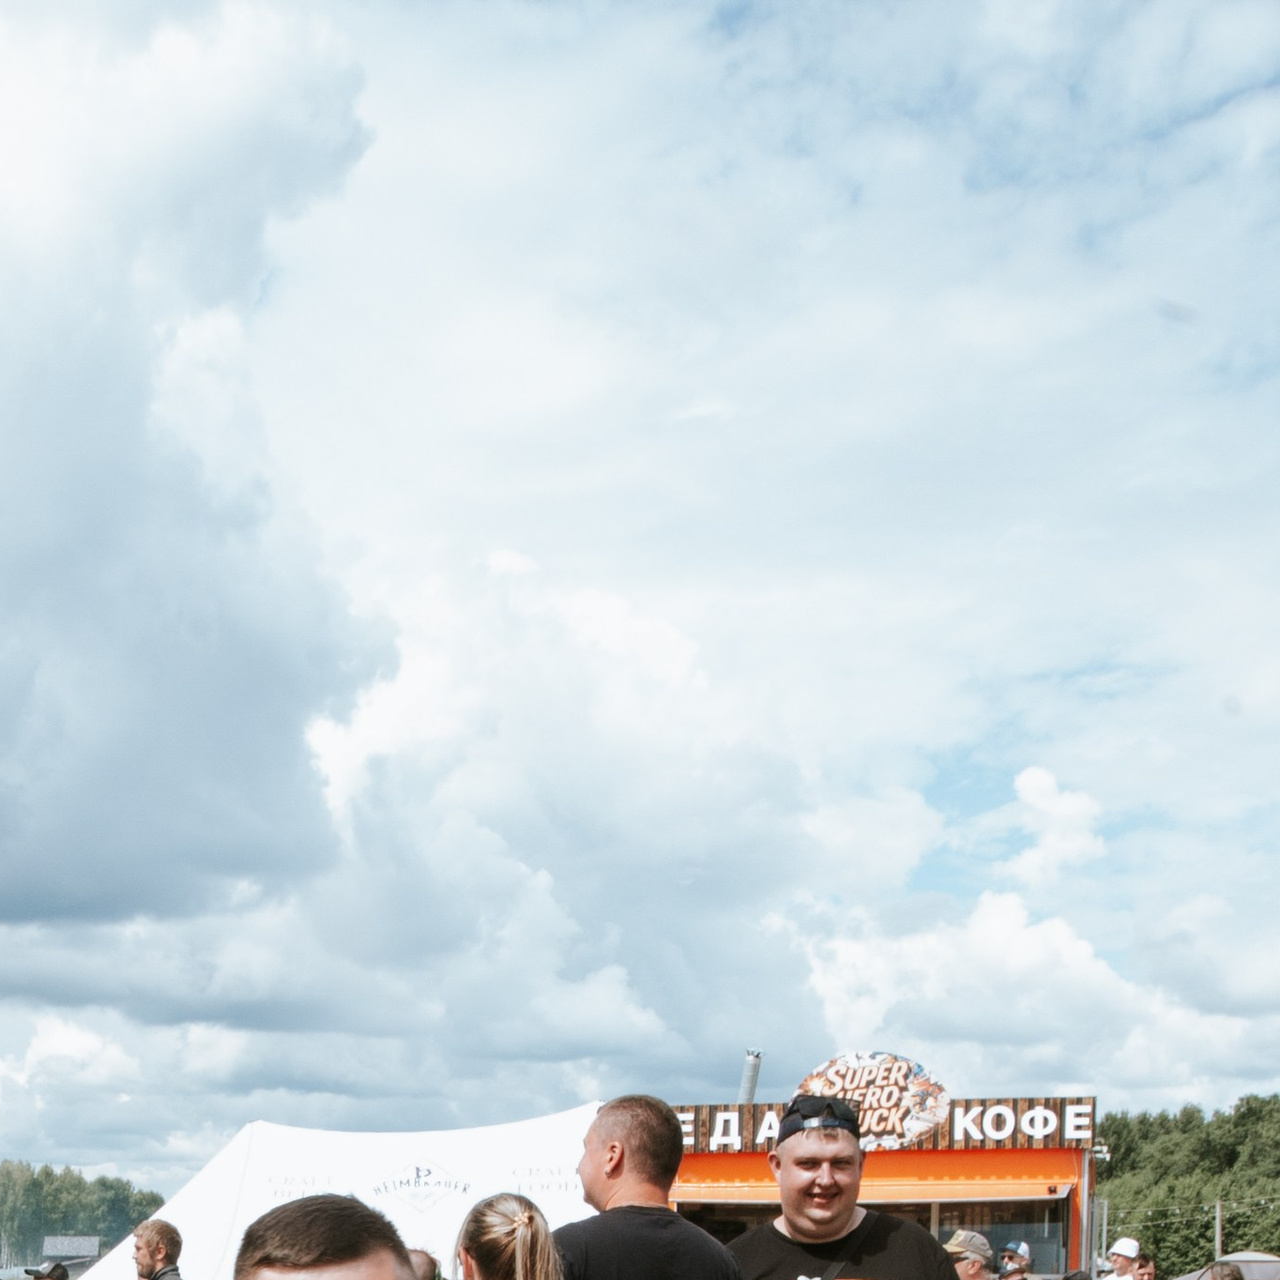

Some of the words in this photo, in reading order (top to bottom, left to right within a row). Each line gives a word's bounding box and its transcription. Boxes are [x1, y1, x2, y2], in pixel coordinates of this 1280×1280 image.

[821, 1061, 910, 1096] SUPER
[859, 1105, 907, 1135] UCK
[953, 1104, 1093, 1141] КОФЕ
